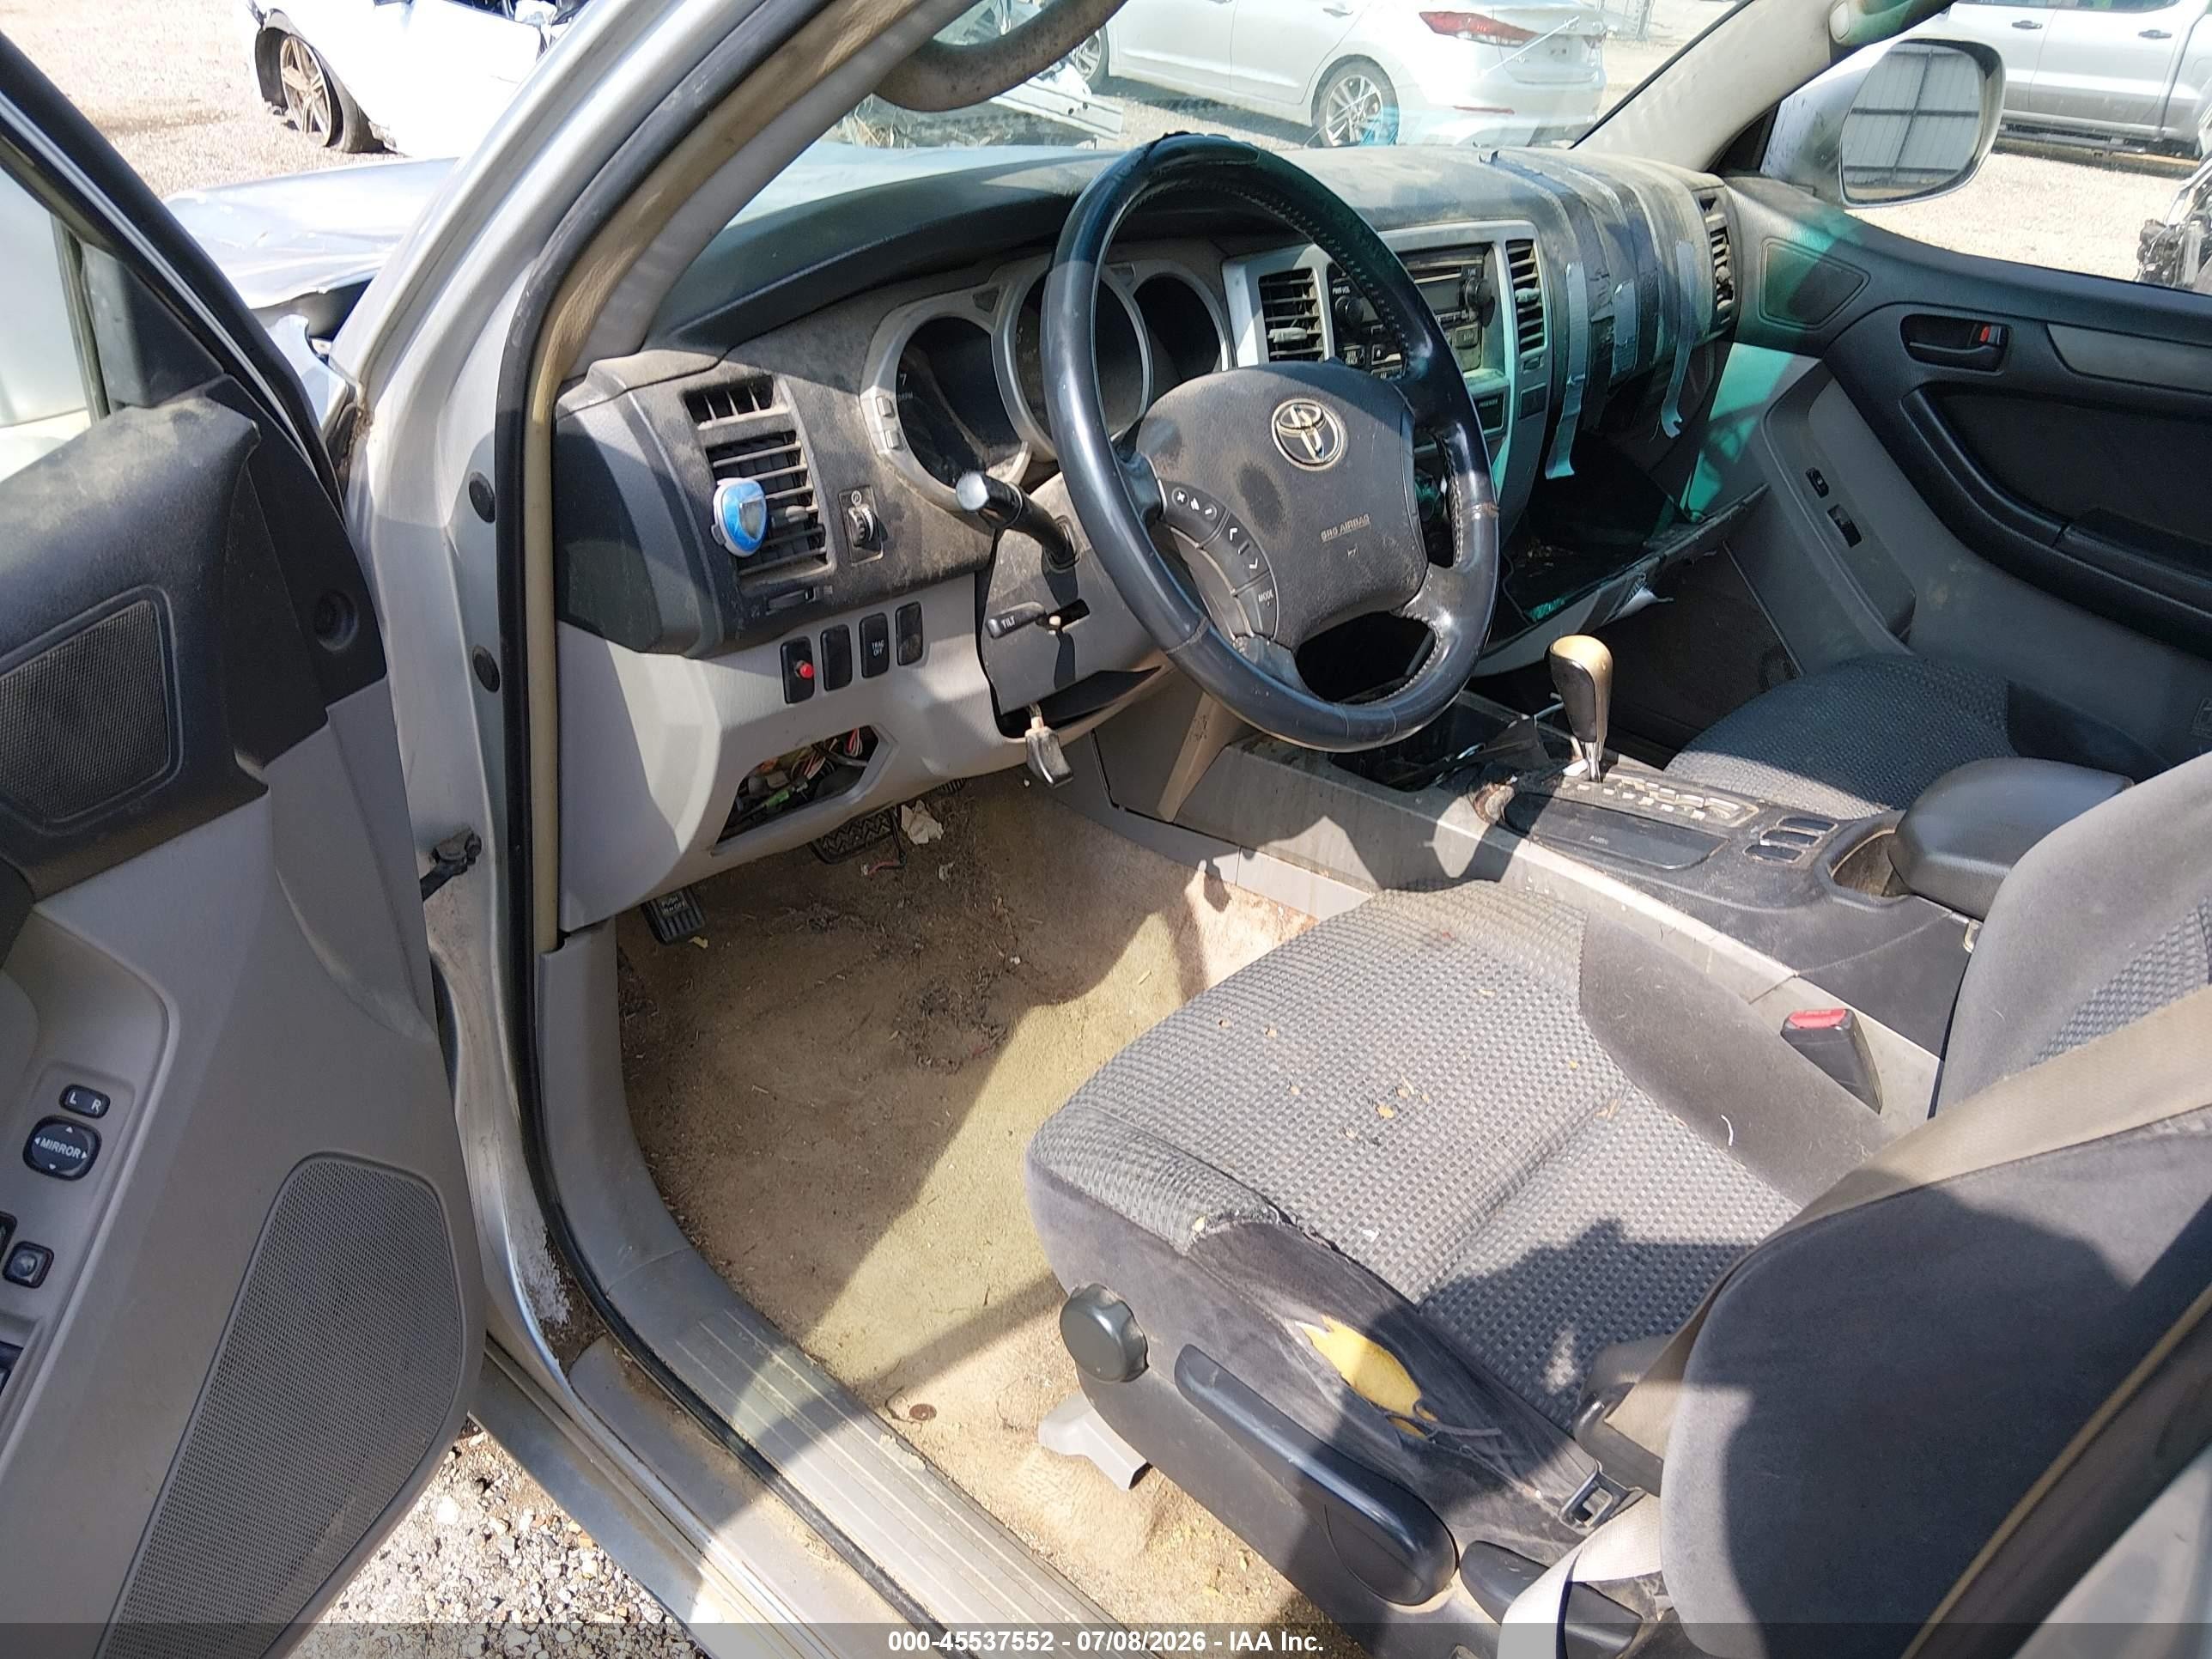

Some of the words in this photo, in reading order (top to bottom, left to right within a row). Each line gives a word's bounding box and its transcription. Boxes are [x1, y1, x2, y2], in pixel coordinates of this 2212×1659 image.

[899, 373, 908, 386] 7
[1340, 514, 1370, 535] AIRBAG
[1258, 589, 1274, 602] MODE
[1000, 615, 1016, 629] TILT
[69, 1091, 77, 1105] L
[90, 1098, 102, 1114] R
[40, 1137, 82, 1159] MIRROR
